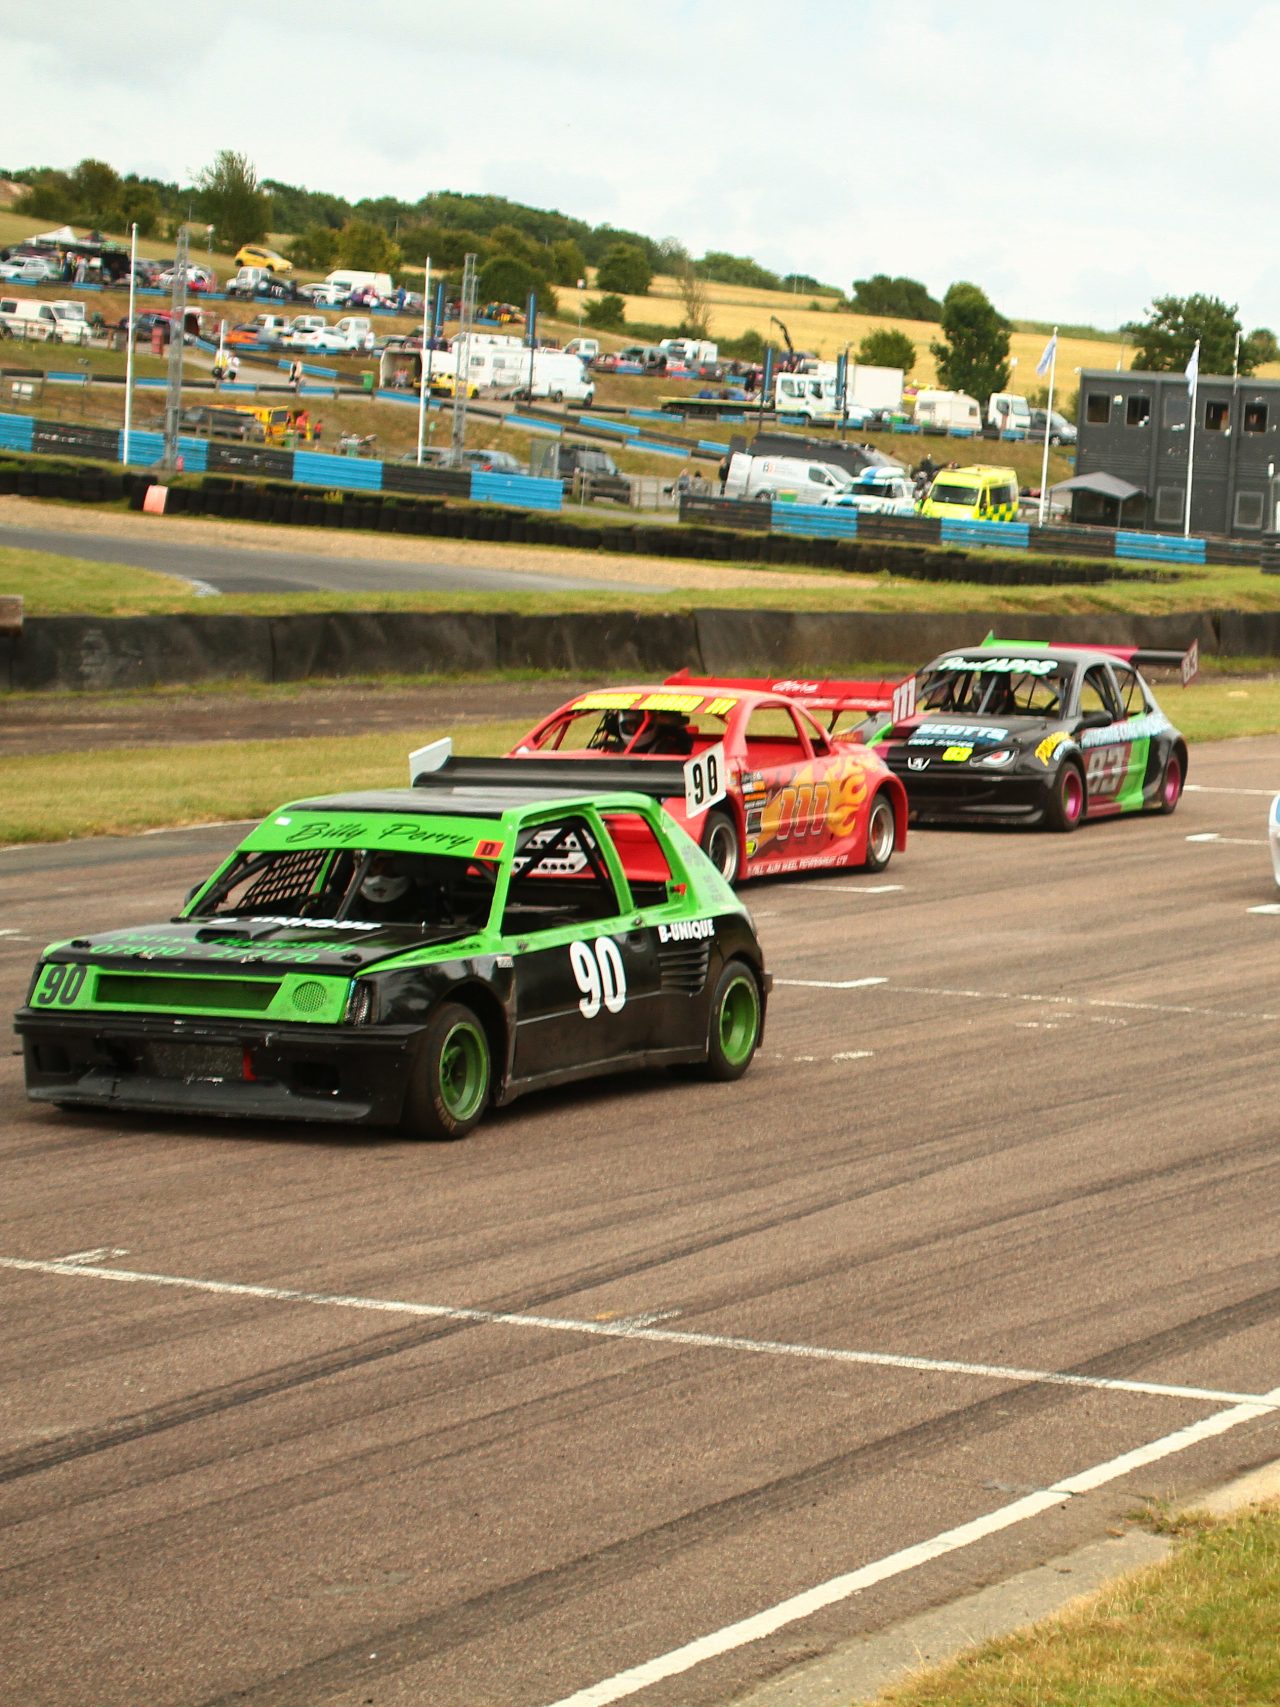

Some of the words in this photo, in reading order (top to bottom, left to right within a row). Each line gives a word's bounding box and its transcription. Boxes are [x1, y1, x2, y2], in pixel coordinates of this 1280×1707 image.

[893, 676, 917, 724] 111
[692, 755, 718, 805] 90
[776, 780, 830, 840] 111
[286, 823, 367, 843] Billy
[378, 823, 474, 850] Perry
[658, 918, 715, 943] B-UNIQUE
[38, 966, 88, 1005] 90
[569, 936, 627, 1019] 90
